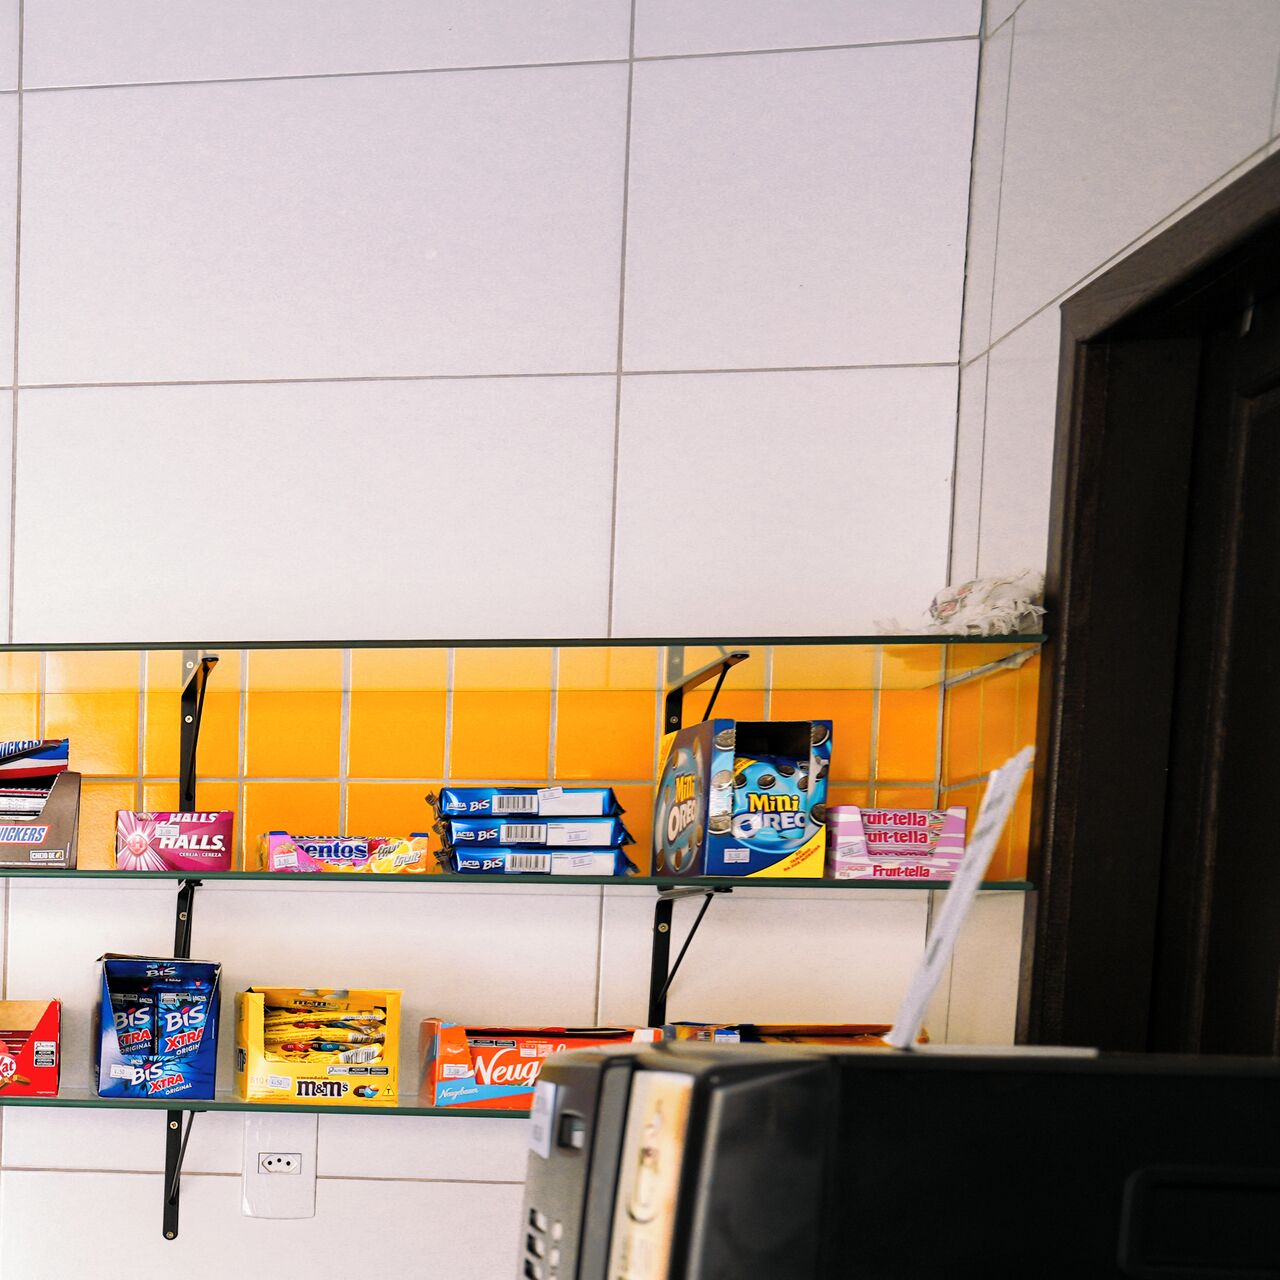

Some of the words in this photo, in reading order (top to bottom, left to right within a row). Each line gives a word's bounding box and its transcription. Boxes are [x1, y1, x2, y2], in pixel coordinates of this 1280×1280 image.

[675, 774, 695, 803] Mini
[749, 793, 799, 813] Mini
[120, 1042, 151, 1054] ORIGINAL
[148, 1074, 184, 1095] XTRA
[165, 1083, 192, 1095] ORIGINAL
